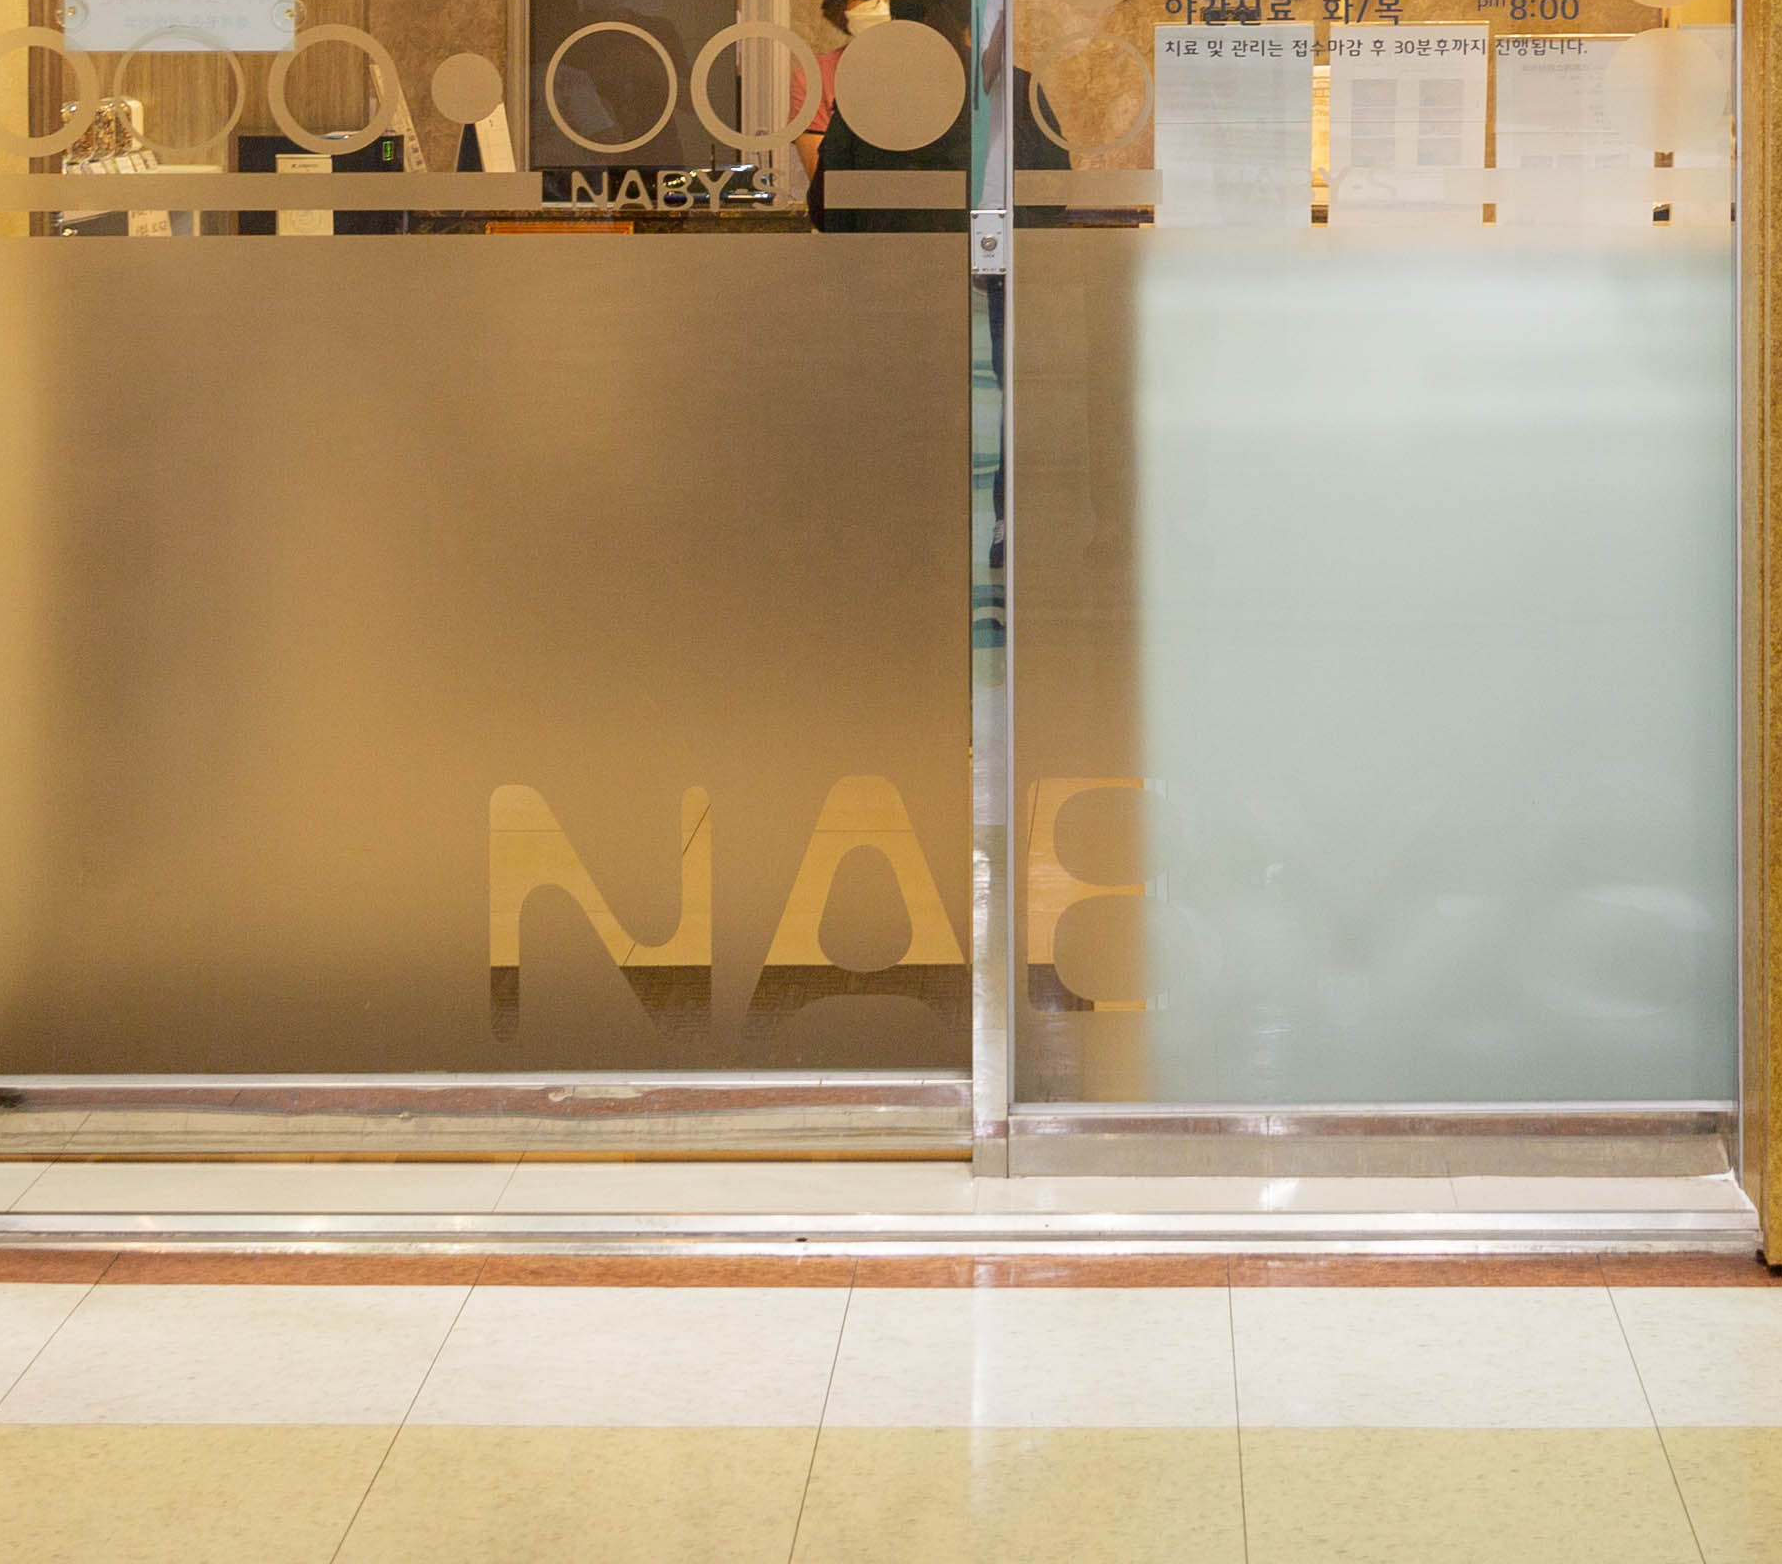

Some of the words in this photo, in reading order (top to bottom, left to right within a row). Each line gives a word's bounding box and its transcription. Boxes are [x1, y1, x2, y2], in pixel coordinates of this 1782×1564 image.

[1165, 40, 1199, 57] 치료
[1207, 40, 1225, 57] 및
[1231, 39, 1284, 57] 관리는
[1292, 39, 1363, 58] 접수마감
[1369, 39, 1387, 56] 후
[1394, 39, 1486, 58] 30분후까지
[1494, 39, 1588, 57] 진행됩니다.
[571, 169, 789, 212] NABY-S
